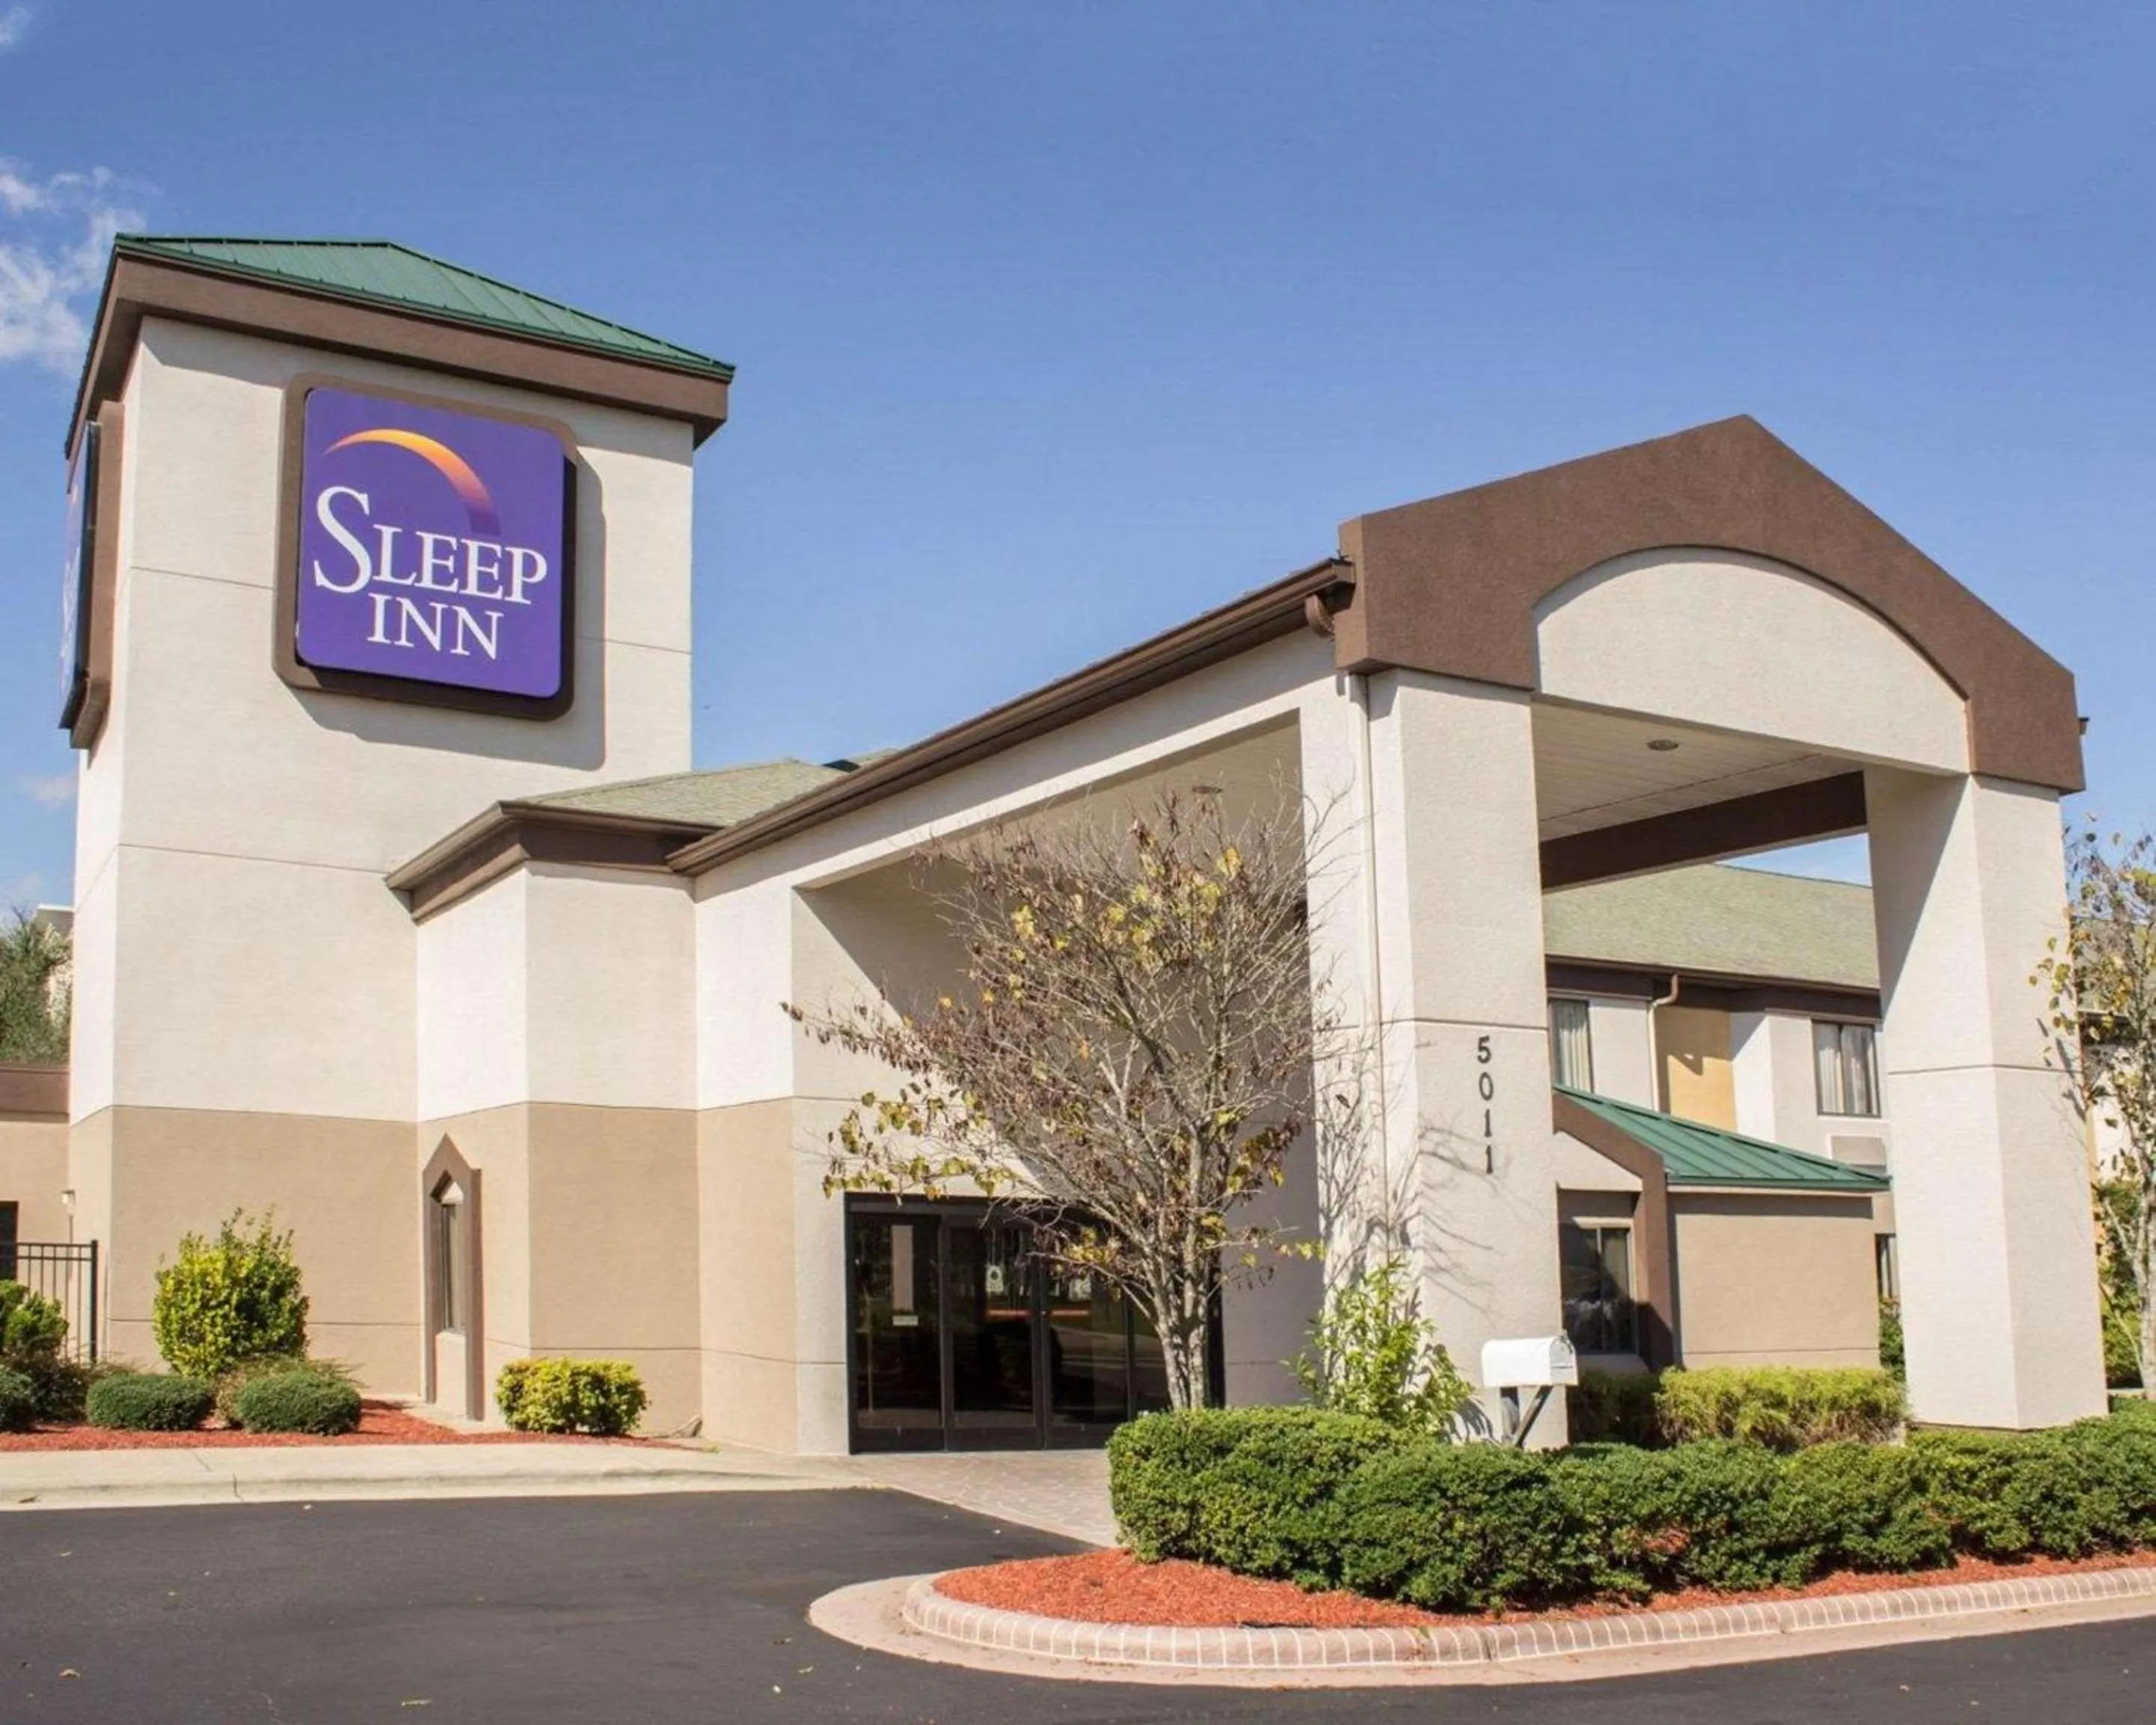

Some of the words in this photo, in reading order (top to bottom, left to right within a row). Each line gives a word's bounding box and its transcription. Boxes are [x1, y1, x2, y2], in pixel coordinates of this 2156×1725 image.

[313, 486, 547, 604] SLEEP
[367, 592, 505, 660] INN
[1477, 1035, 1494, 1175] 5011
